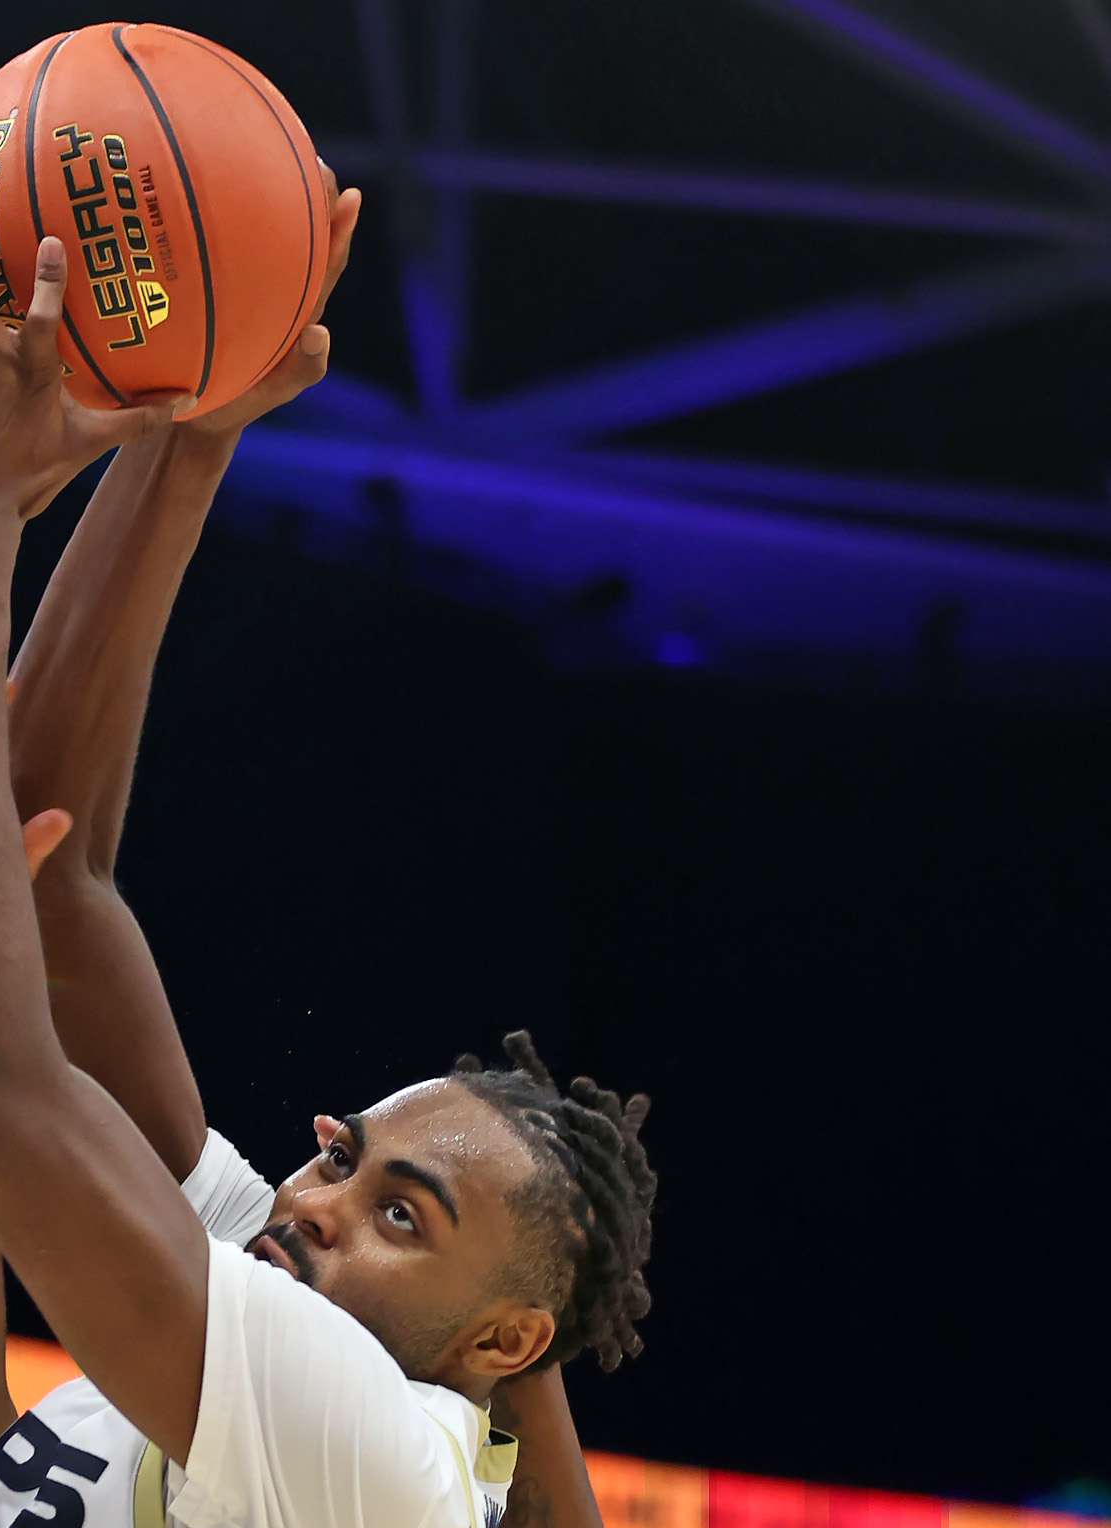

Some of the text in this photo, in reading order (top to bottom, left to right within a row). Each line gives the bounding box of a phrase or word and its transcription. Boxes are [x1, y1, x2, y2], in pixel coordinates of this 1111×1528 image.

[53, 122, 147, 352] LEGACY
[101, 133, 155, 276] 1000
[139, 164, 178, 281] OFFICIAL GAME BALL
